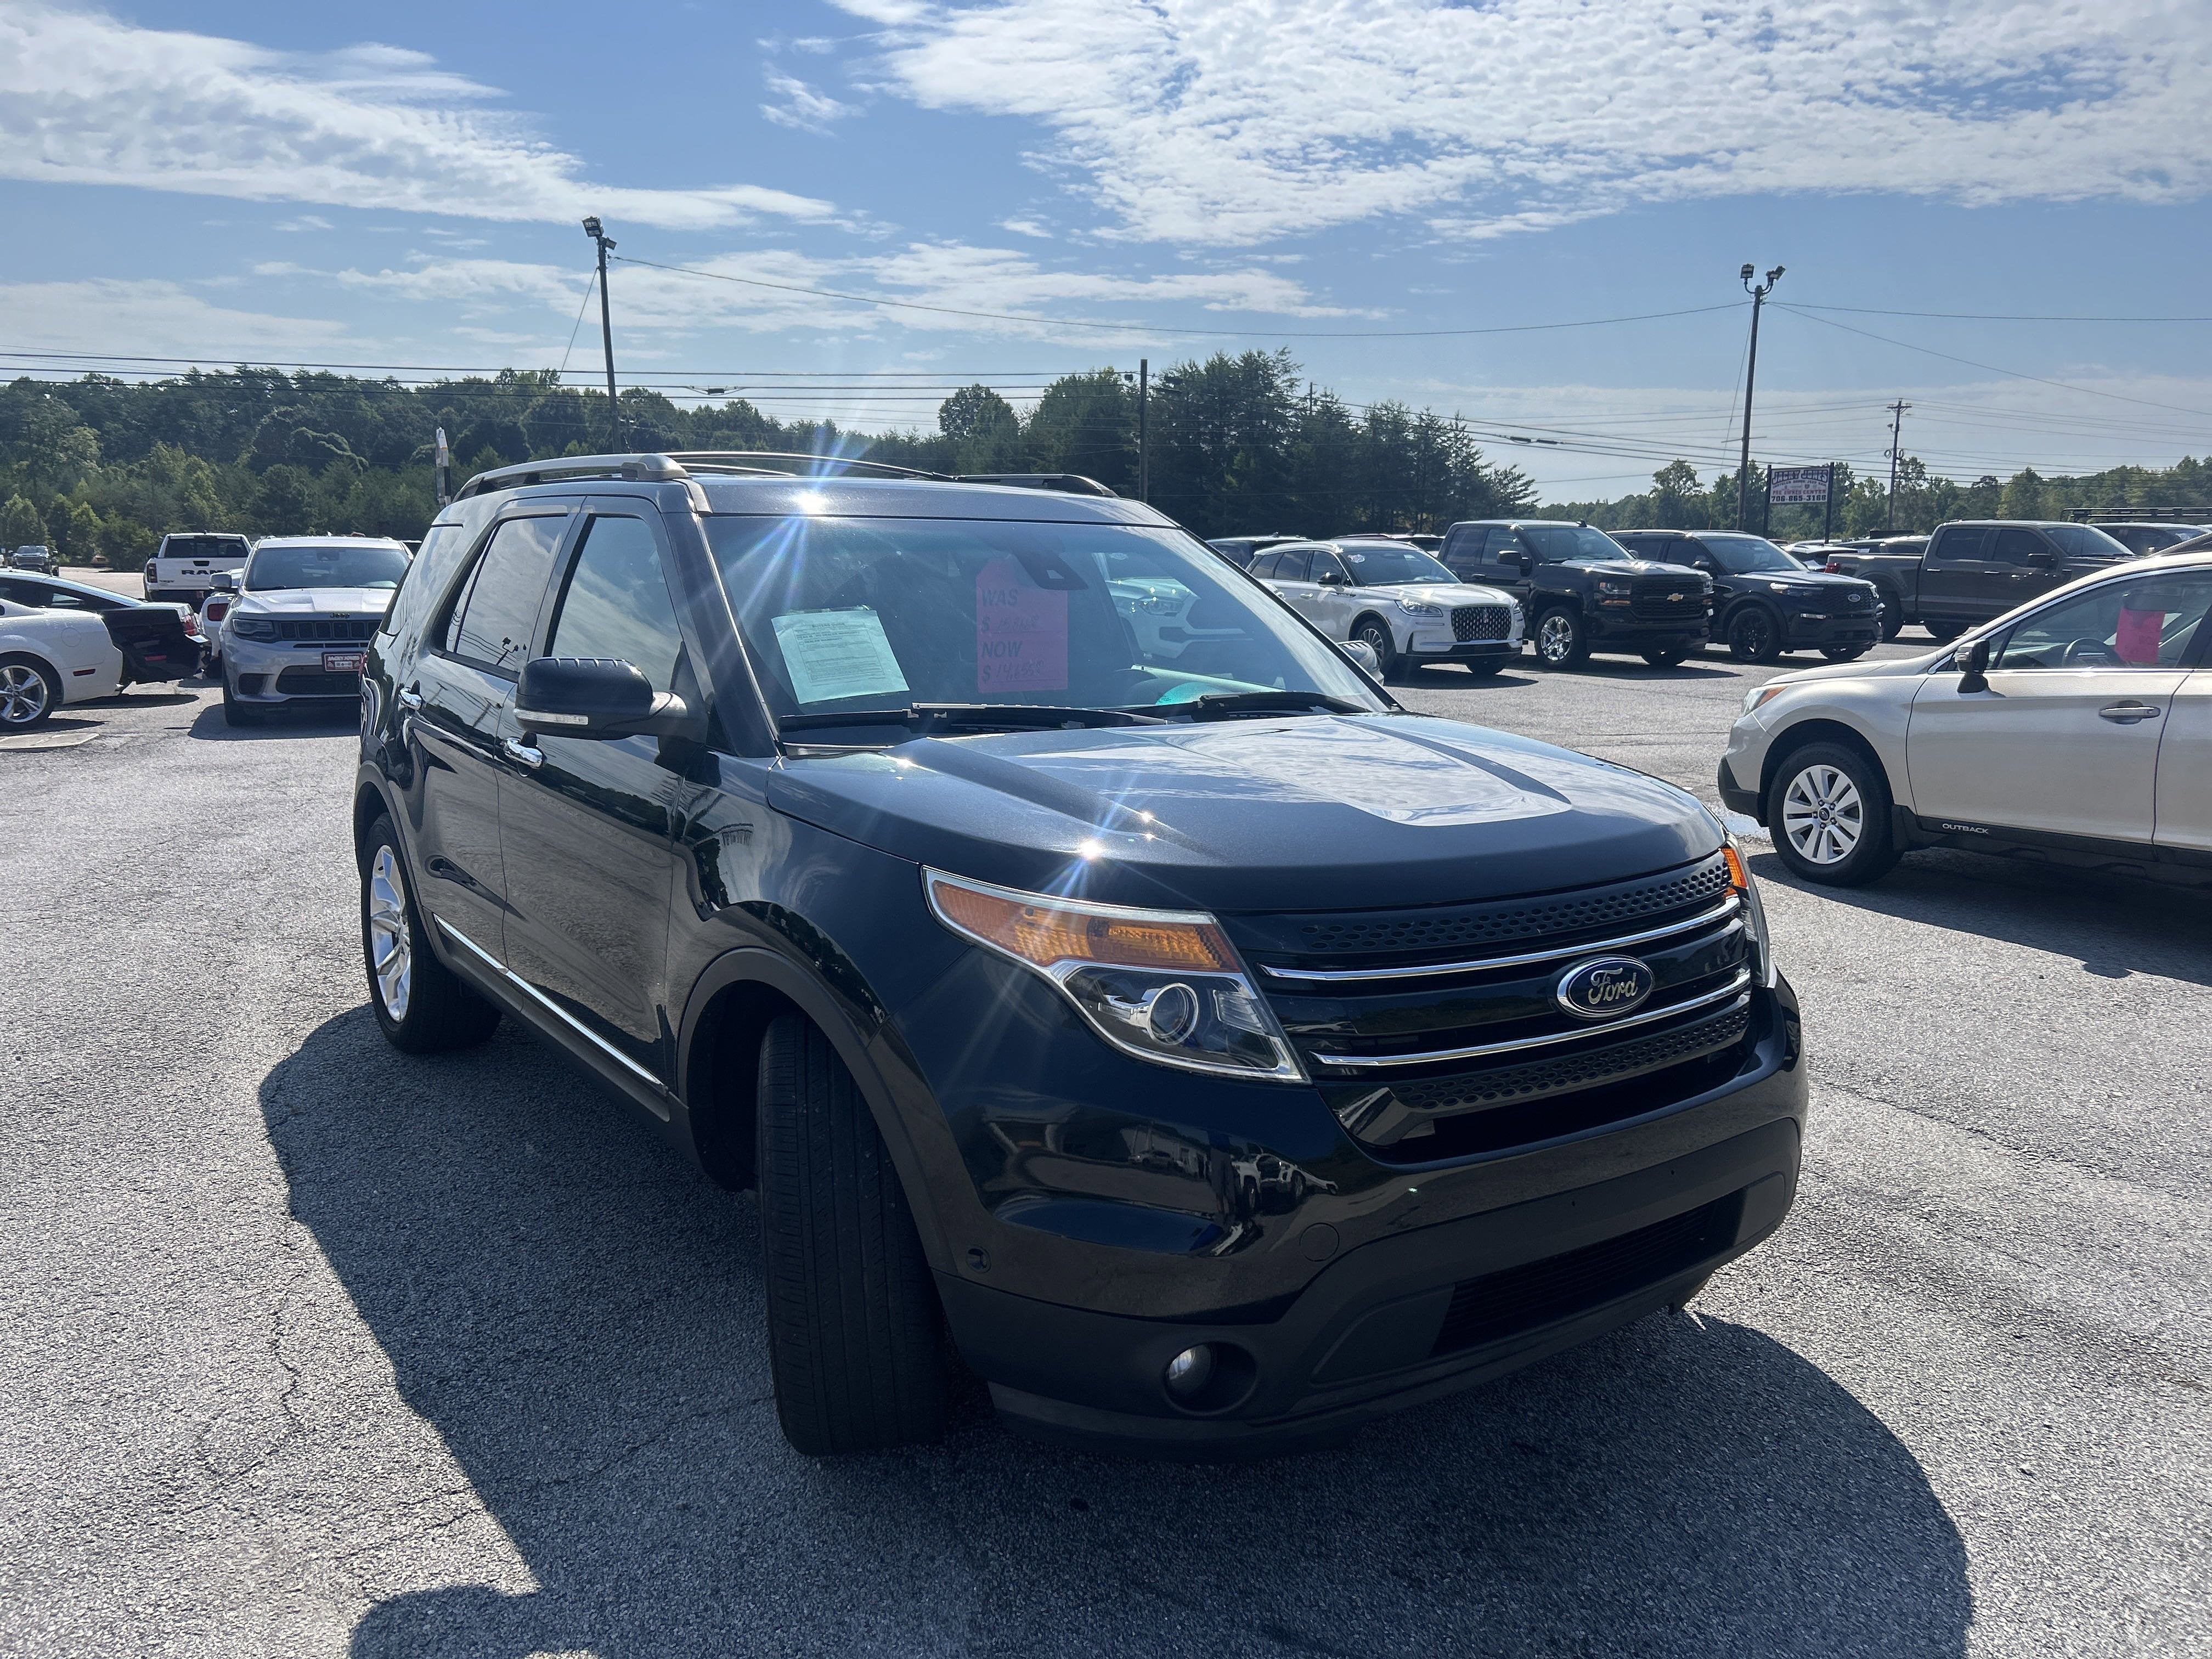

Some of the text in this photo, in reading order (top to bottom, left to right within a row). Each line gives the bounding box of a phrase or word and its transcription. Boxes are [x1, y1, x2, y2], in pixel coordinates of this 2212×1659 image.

[1772, 470, 1829, 484] JACKY JONES
[983, 588, 1018, 606] WAS
[982, 641, 1023, 658] NOW
[1942, 823, 1989, 834] OUTBACK
[1588, 968, 1638, 1004] Ford
